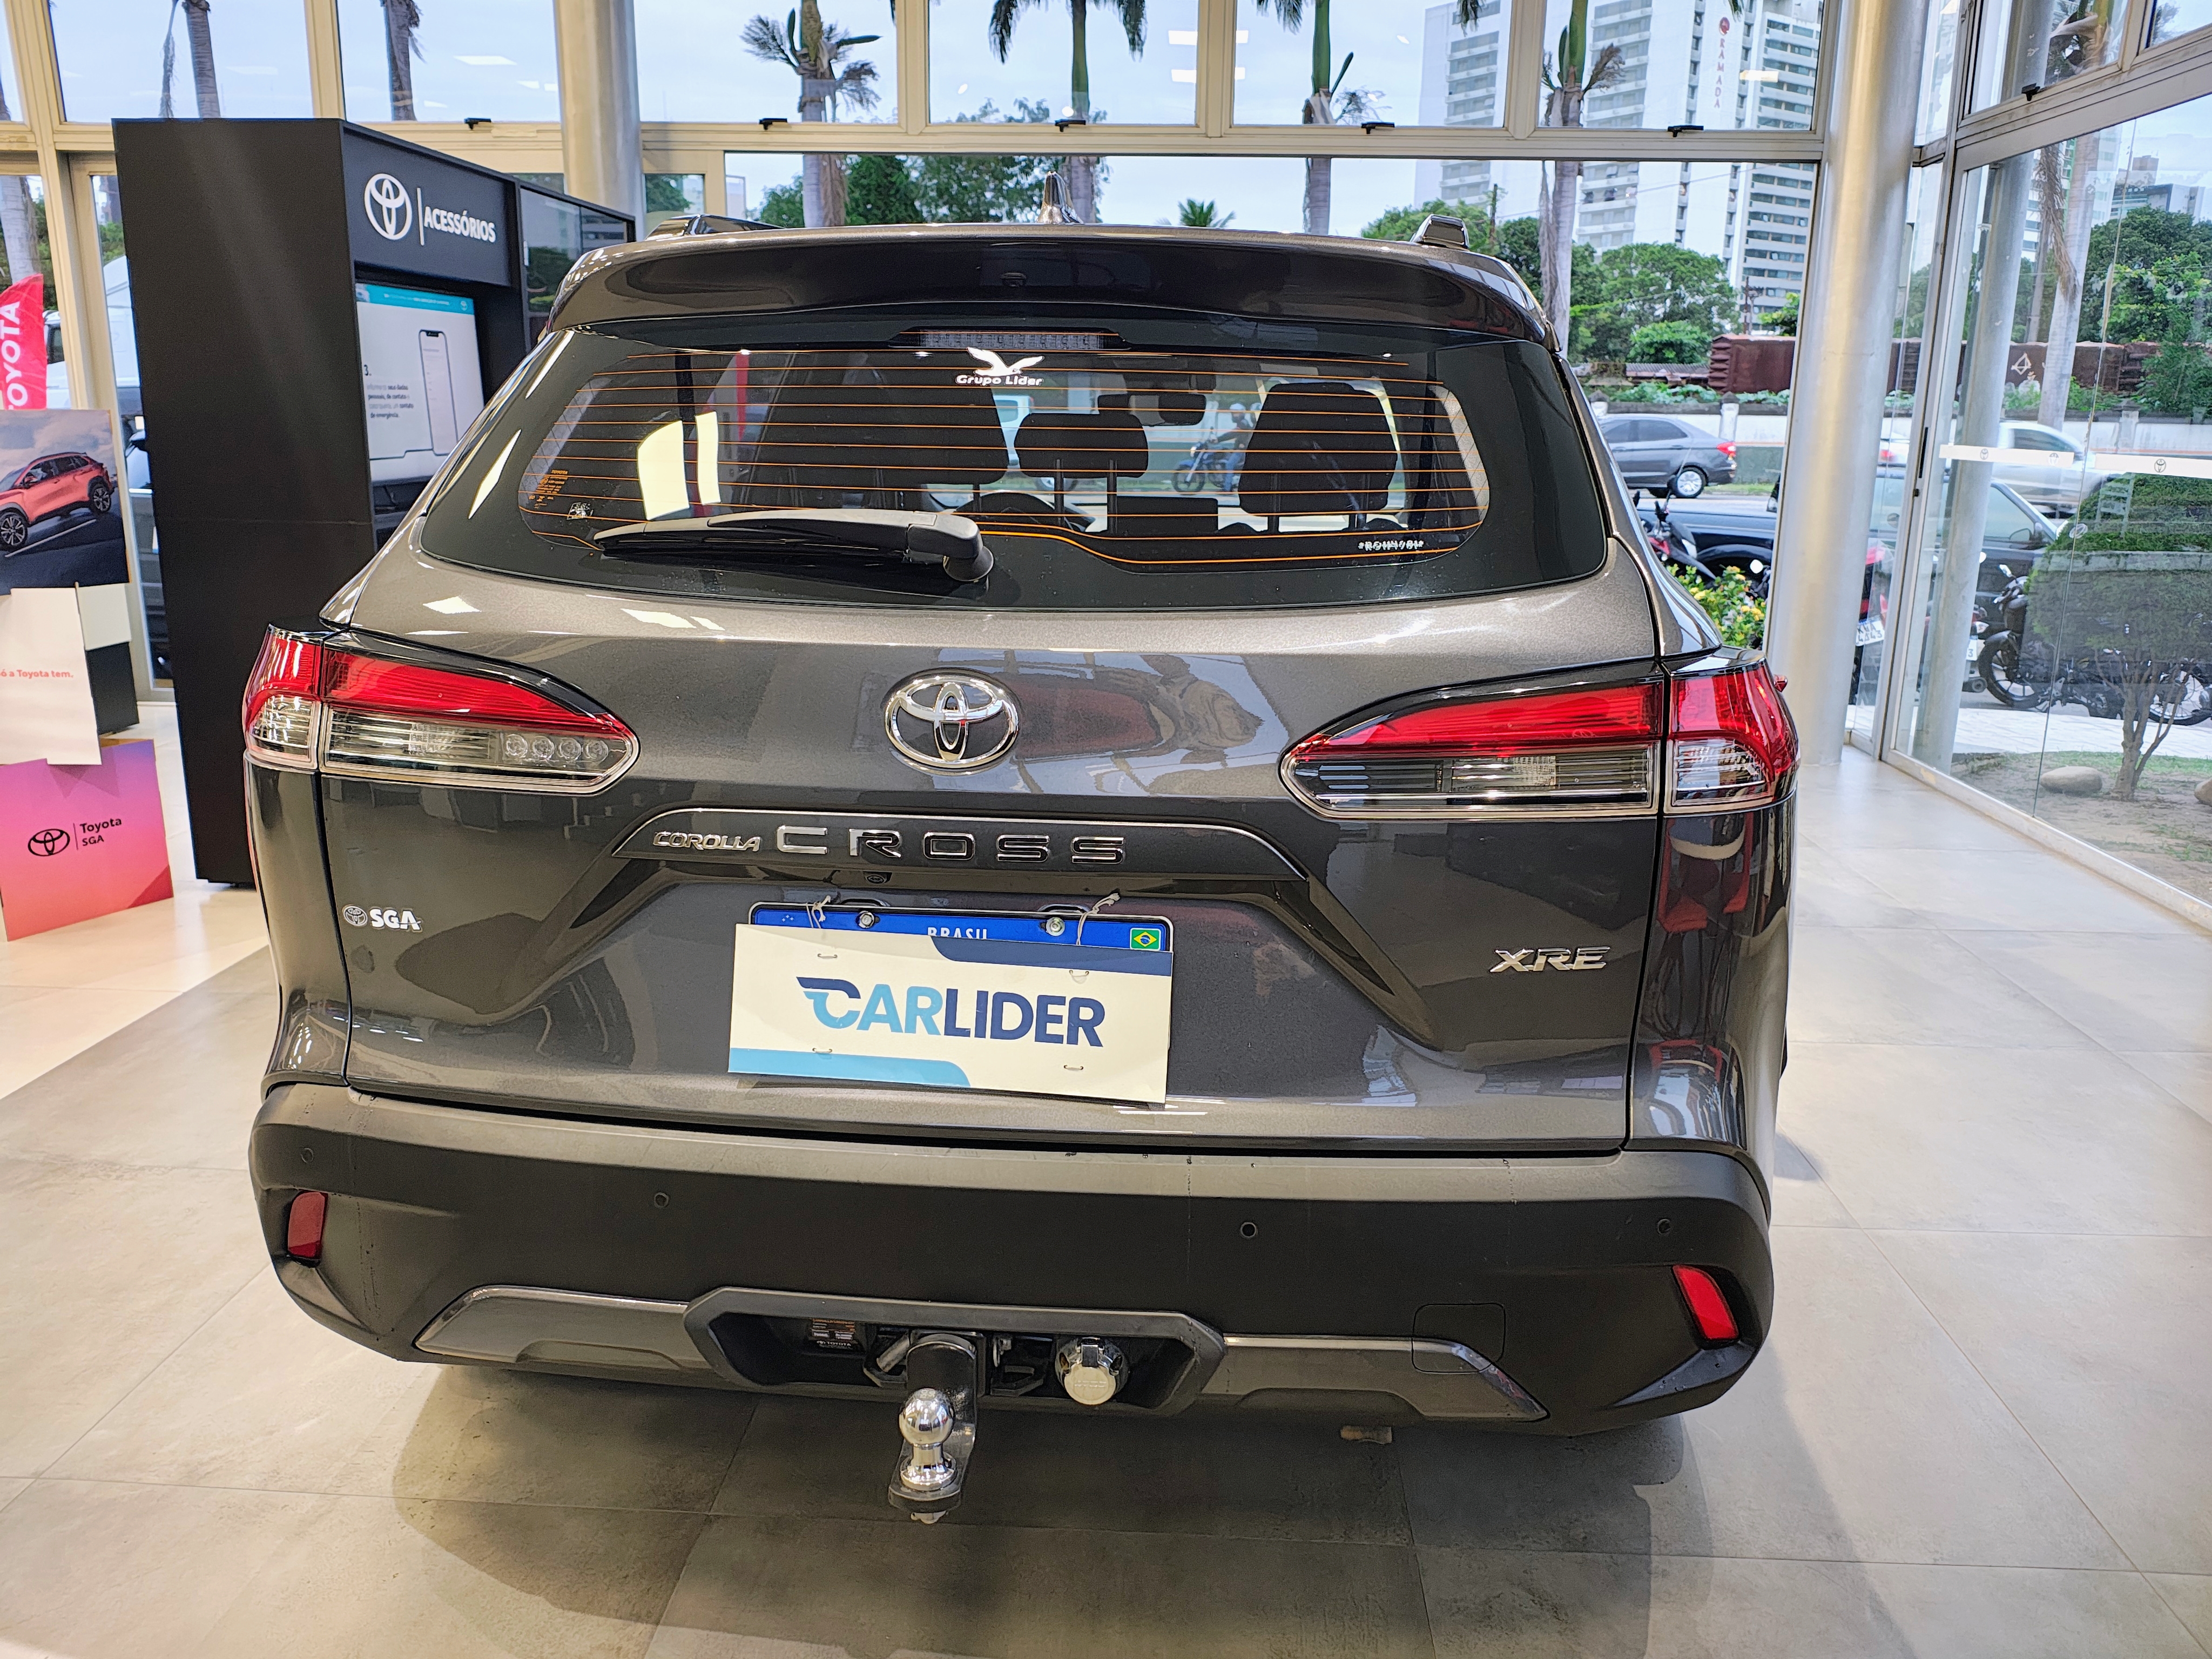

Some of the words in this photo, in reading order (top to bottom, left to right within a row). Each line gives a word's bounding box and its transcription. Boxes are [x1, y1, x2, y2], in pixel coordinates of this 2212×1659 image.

[1714, 38, 1725, 109] RAMADA
[424, 206, 496, 243] ACESSÓRIOS
[0, 301, 28, 409] OYOTA
[956, 374, 1001, 386] Grupo
[0, 669, 7, 677] ó
[16, 669, 49, 679] Toyota
[51, 670, 73, 678] tem.
[79, 818, 122, 833] Toyota
[82, 835, 104, 846] SGA
[653, 831, 761, 852] COROLLA
[776, 825, 1126, 865] CROSS
[369, 908, 421, 930] SGA
[1489, 946, 1610, 973] XRE
[796, 976, 1105, 1047] CARLIDER
